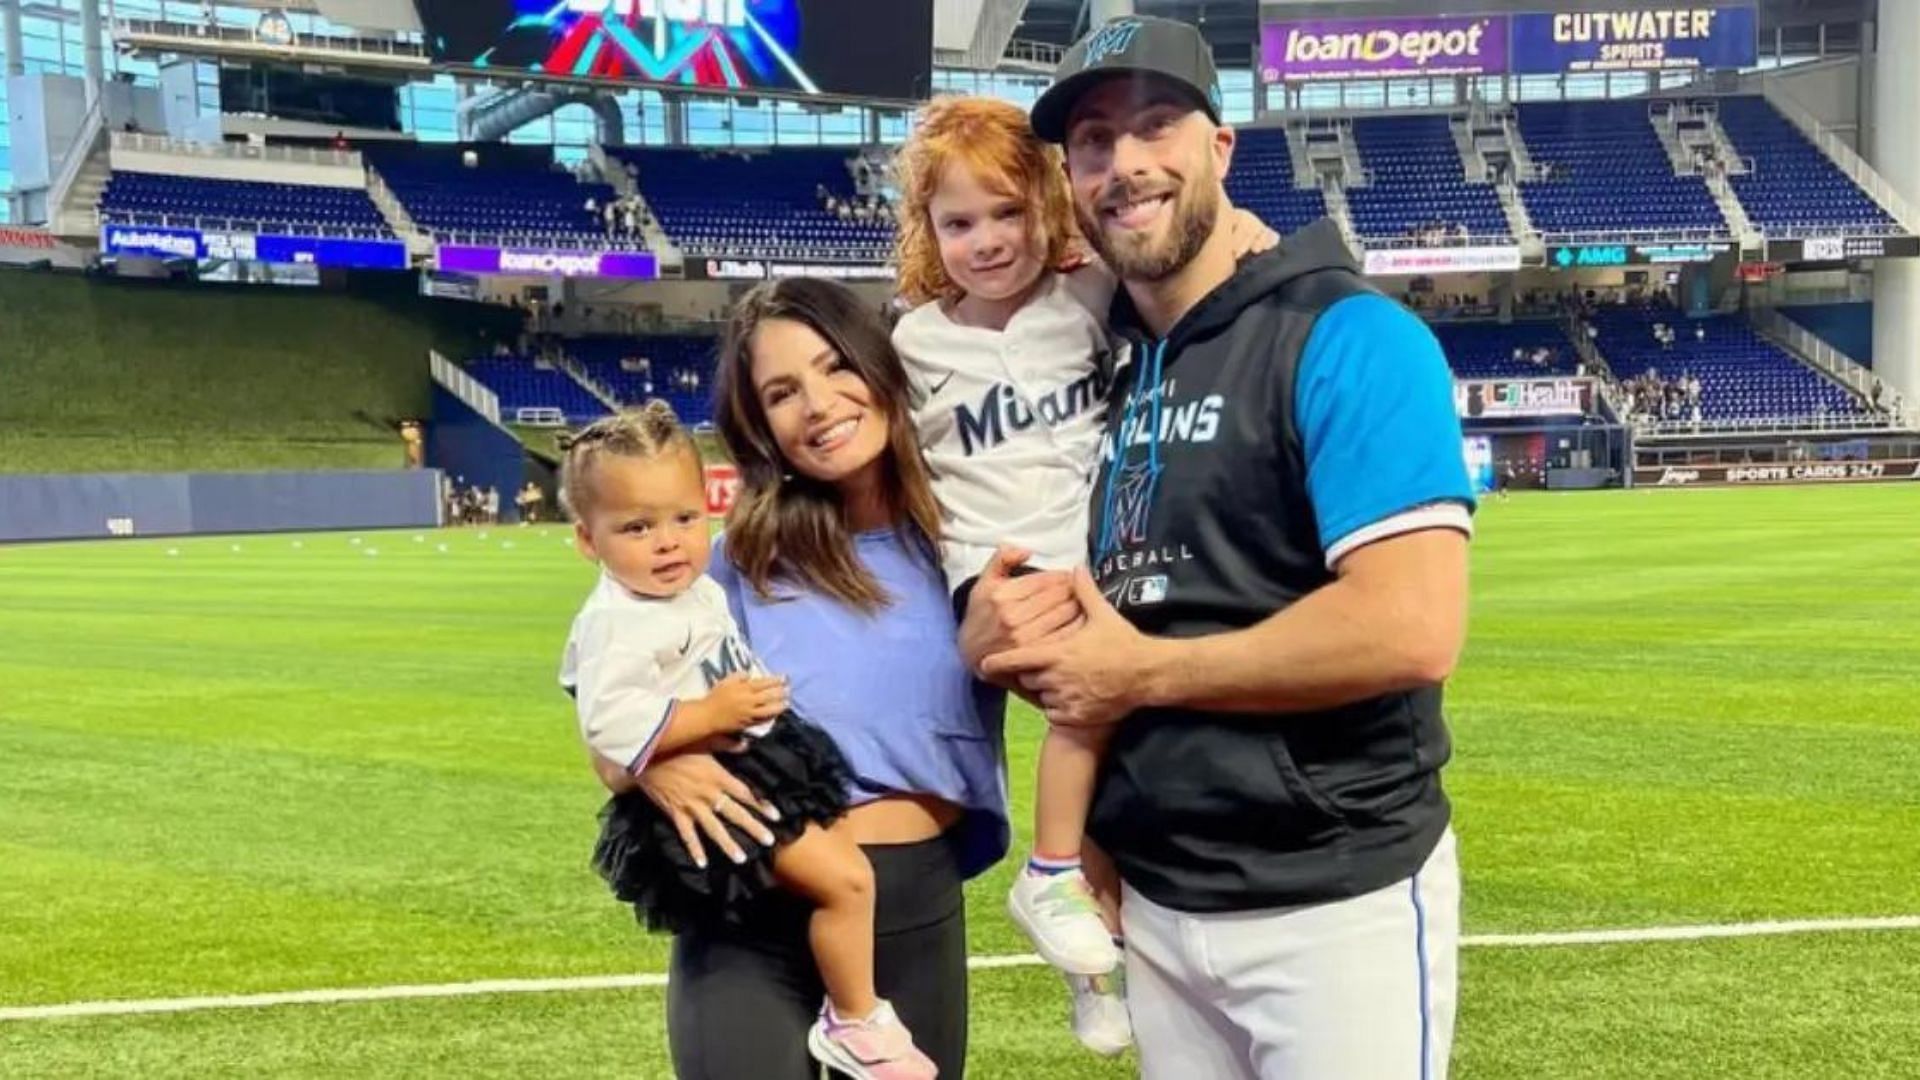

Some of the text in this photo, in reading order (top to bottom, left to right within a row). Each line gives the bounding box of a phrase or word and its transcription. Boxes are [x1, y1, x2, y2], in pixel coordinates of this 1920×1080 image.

[1553, 10, 1710, 42] CUTWATER
[1285, 24, 1482, 64] loanDepot
[1601, 43, 1663, 60] SPIRITS
[1577, 246, 1626, 264] AMG
[954, 367, 1105, 457] Miam
[1727, 464, 1884, 481] SPORTS CARDS 24/7
